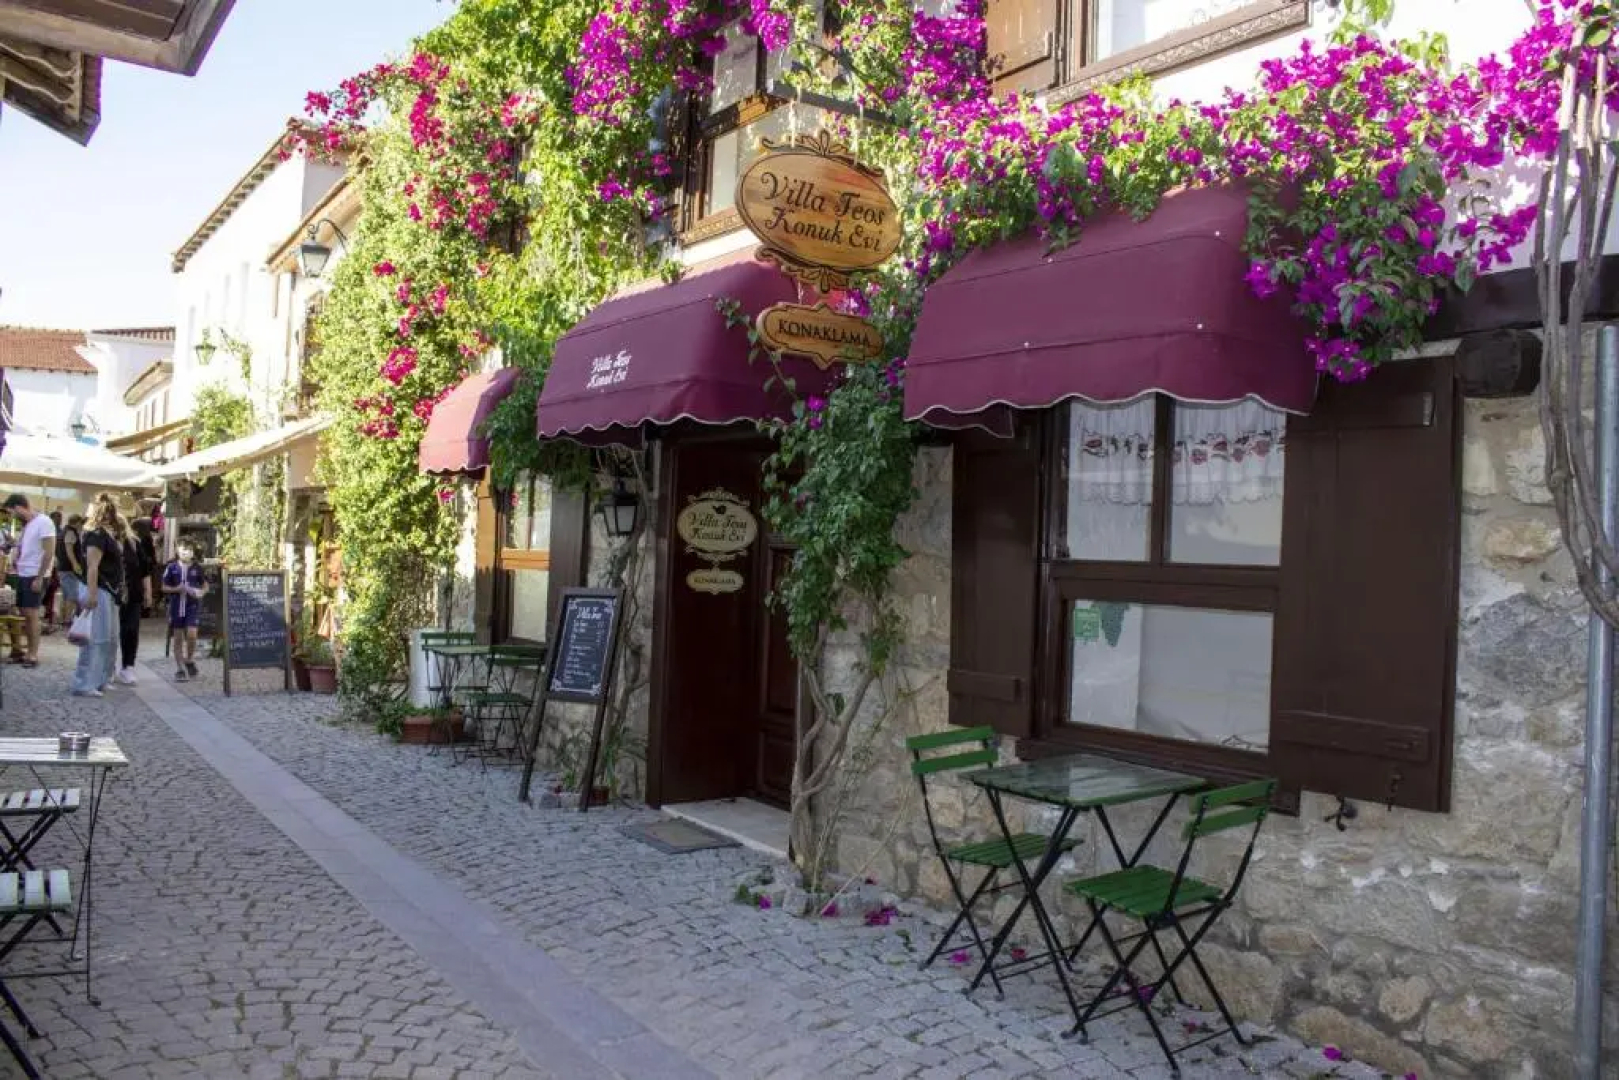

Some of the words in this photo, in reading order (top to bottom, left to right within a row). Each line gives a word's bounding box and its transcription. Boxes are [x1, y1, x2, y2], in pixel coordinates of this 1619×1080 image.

[761, 171, 826, 212] Villa
[834, 192, 885, 224] Teos
[765, 207, 844, 245] Konuk
[848, 227, 882, 252] Evi
[778, 319, 871, 347] KONAKLAMA
